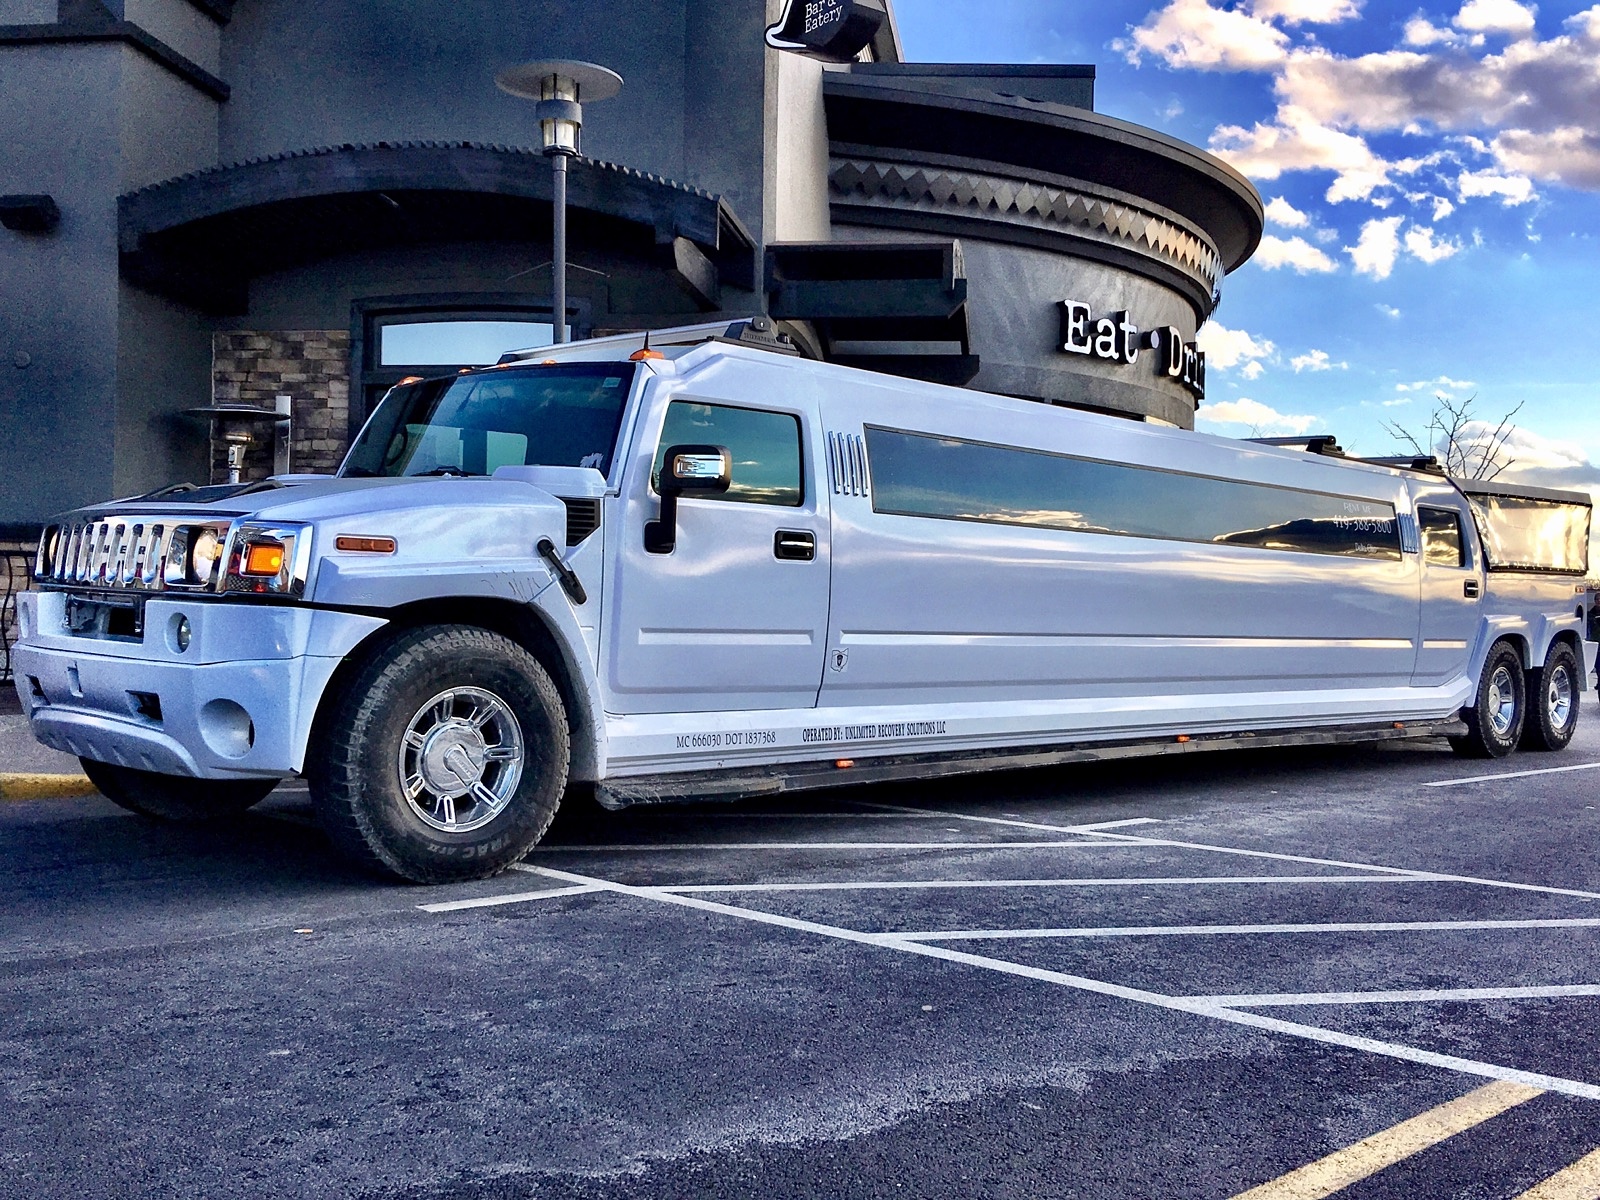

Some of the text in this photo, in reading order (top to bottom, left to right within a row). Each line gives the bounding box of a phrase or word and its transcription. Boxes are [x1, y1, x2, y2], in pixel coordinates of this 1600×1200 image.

[805, 0, 825, 18] Bar
[805, 5, 842, 33] Eatery
[1063, 299, 1140, 365] Eat
[1333, 514, 1392, 534] 419-388-5800
[676, 731, 777, 748] MC 666030 DOT 1837368
[802, 720, 946, 742] OPERATED BY: UNLIMITED RECOVERY SOLUTIONS LLC
